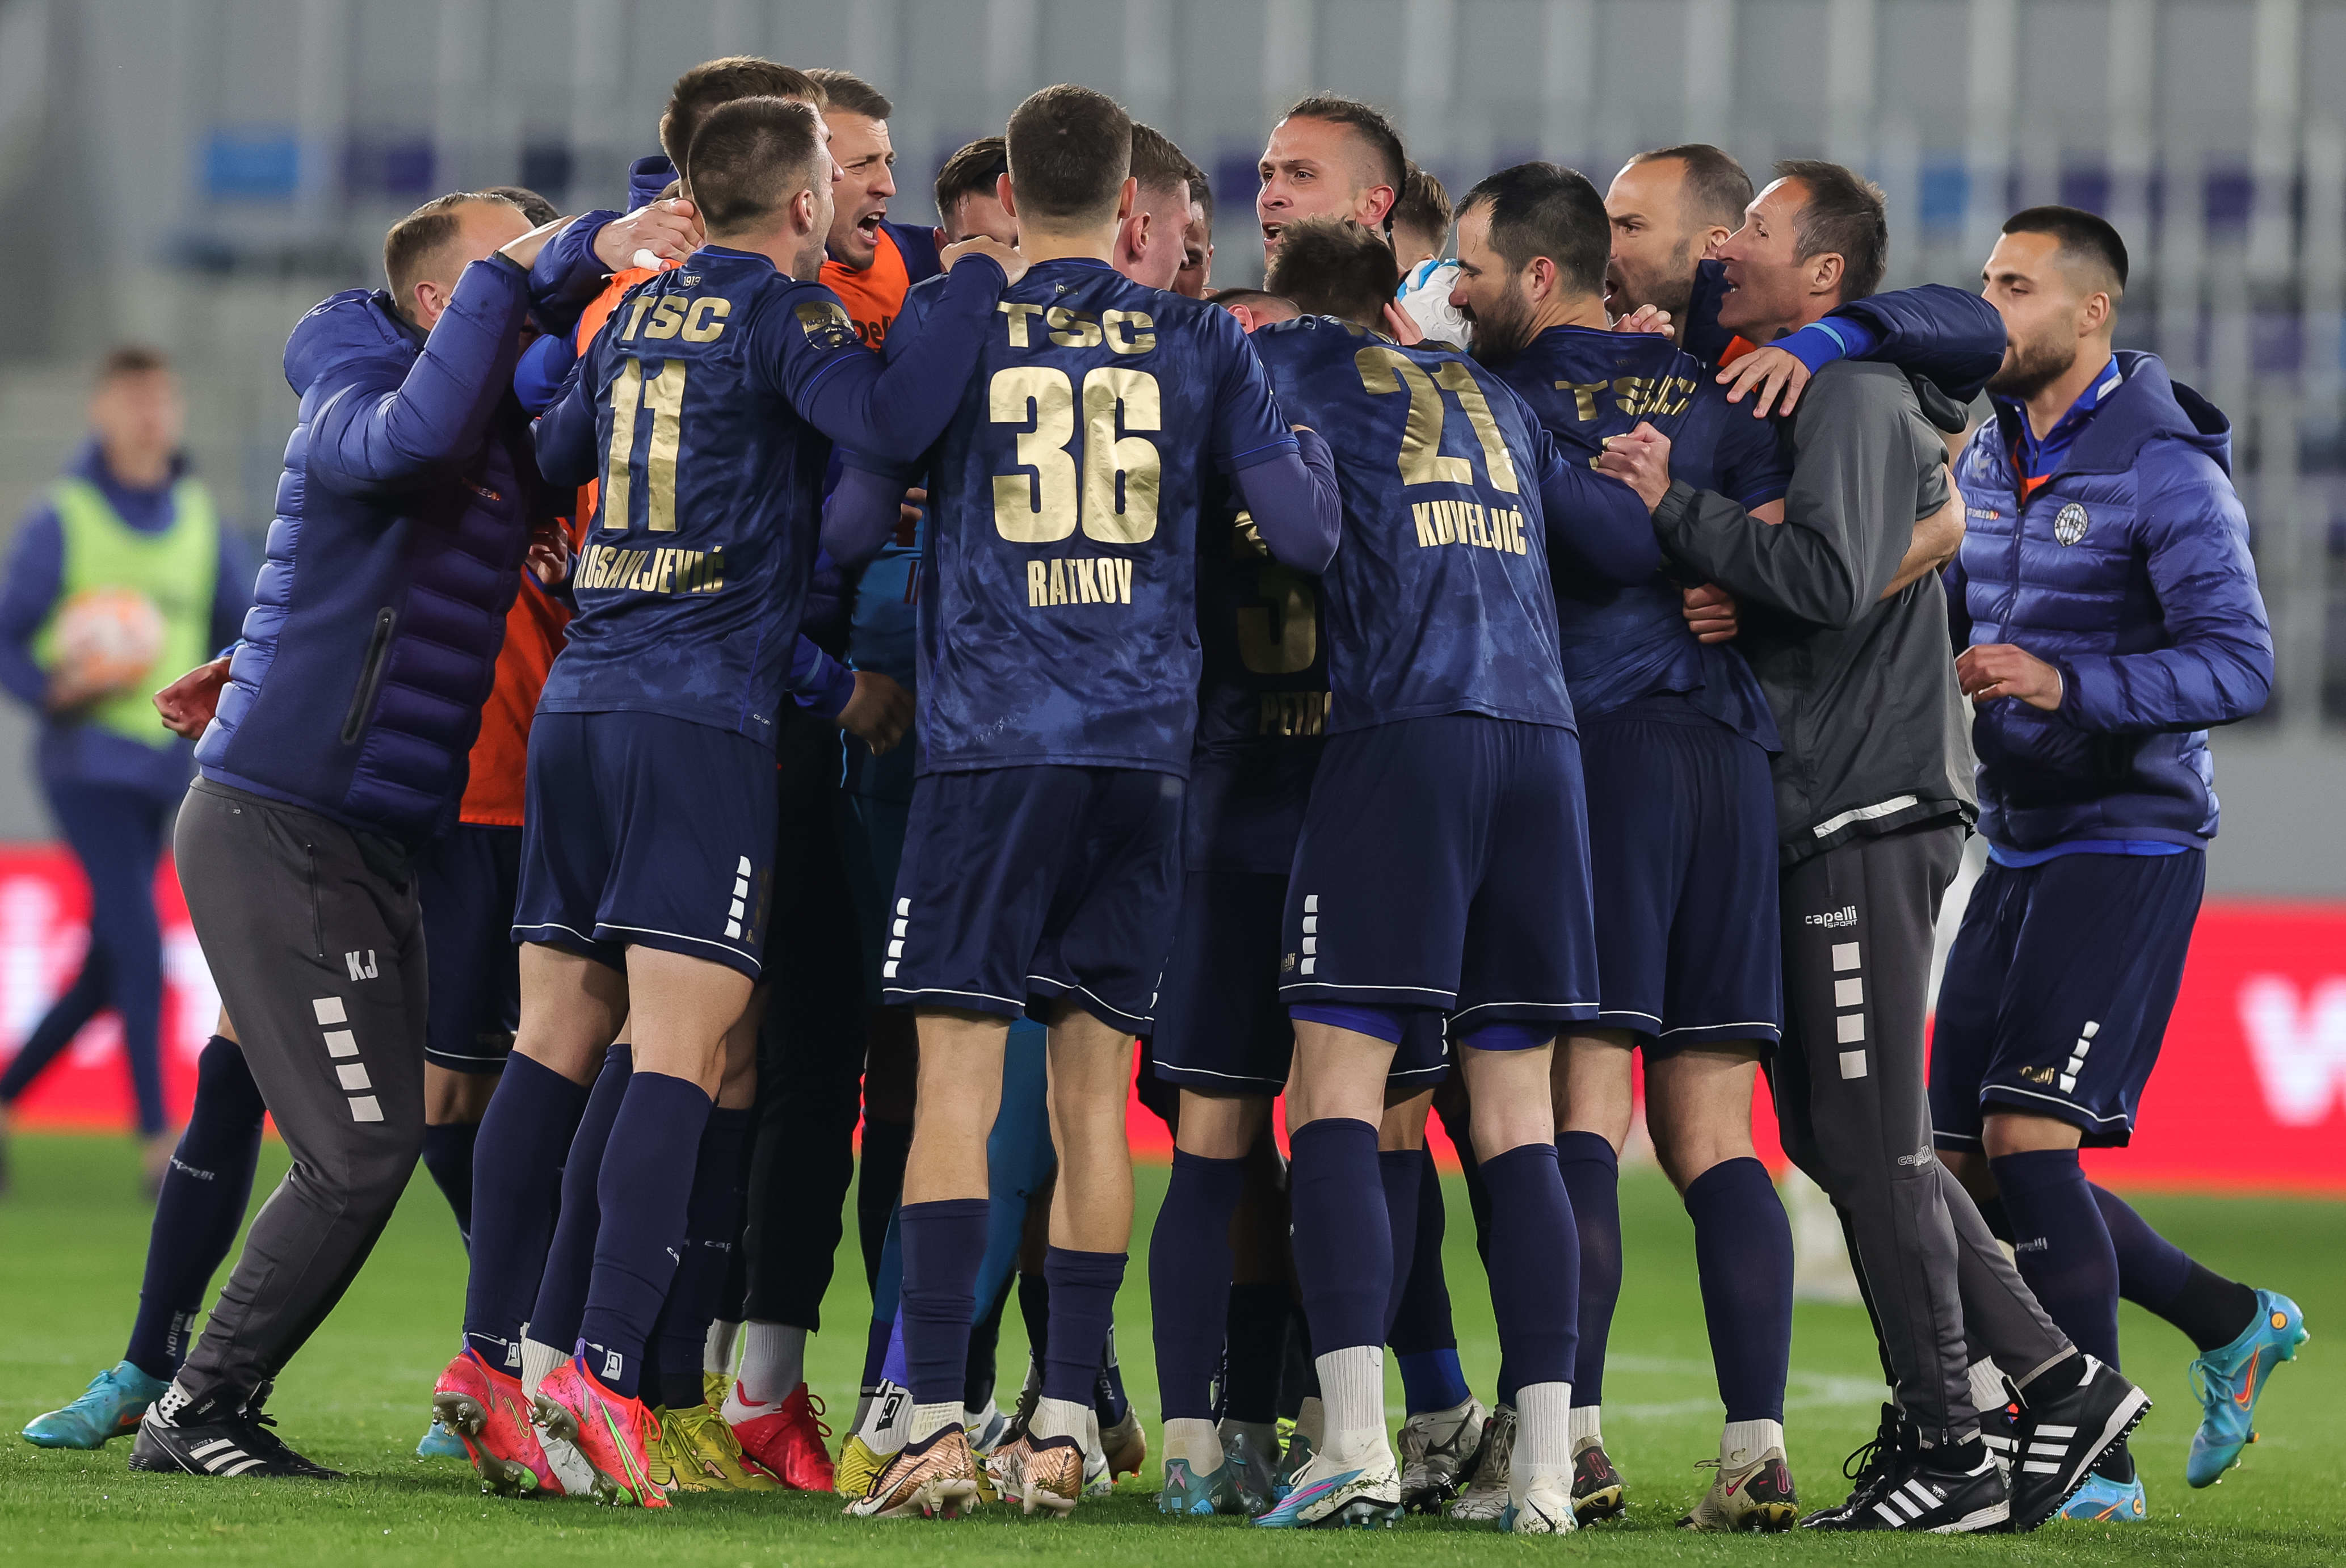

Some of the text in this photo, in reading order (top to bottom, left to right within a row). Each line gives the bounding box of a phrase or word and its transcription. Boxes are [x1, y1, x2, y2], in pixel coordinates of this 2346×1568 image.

[683, 276, 701, 287] 1913
[622, 296, 731, 342] TSC
[997, 301, 1156, 354] TSC
[1355, 346, 1519, 494] 21
[1555, 375, 1697, 422] TSC
[604, 358, 686, 532] 11
[989, 367, 1161, 543] 36
[1411, 505, 1527, 555] KUVELJIĆ
[1028, 558, 1132, 607] RATKOV
[1805, 905, 1857, 927] capelli
[1827, 919, 1857, 928] SPORT
[345, 949, 379, 981] KJ
